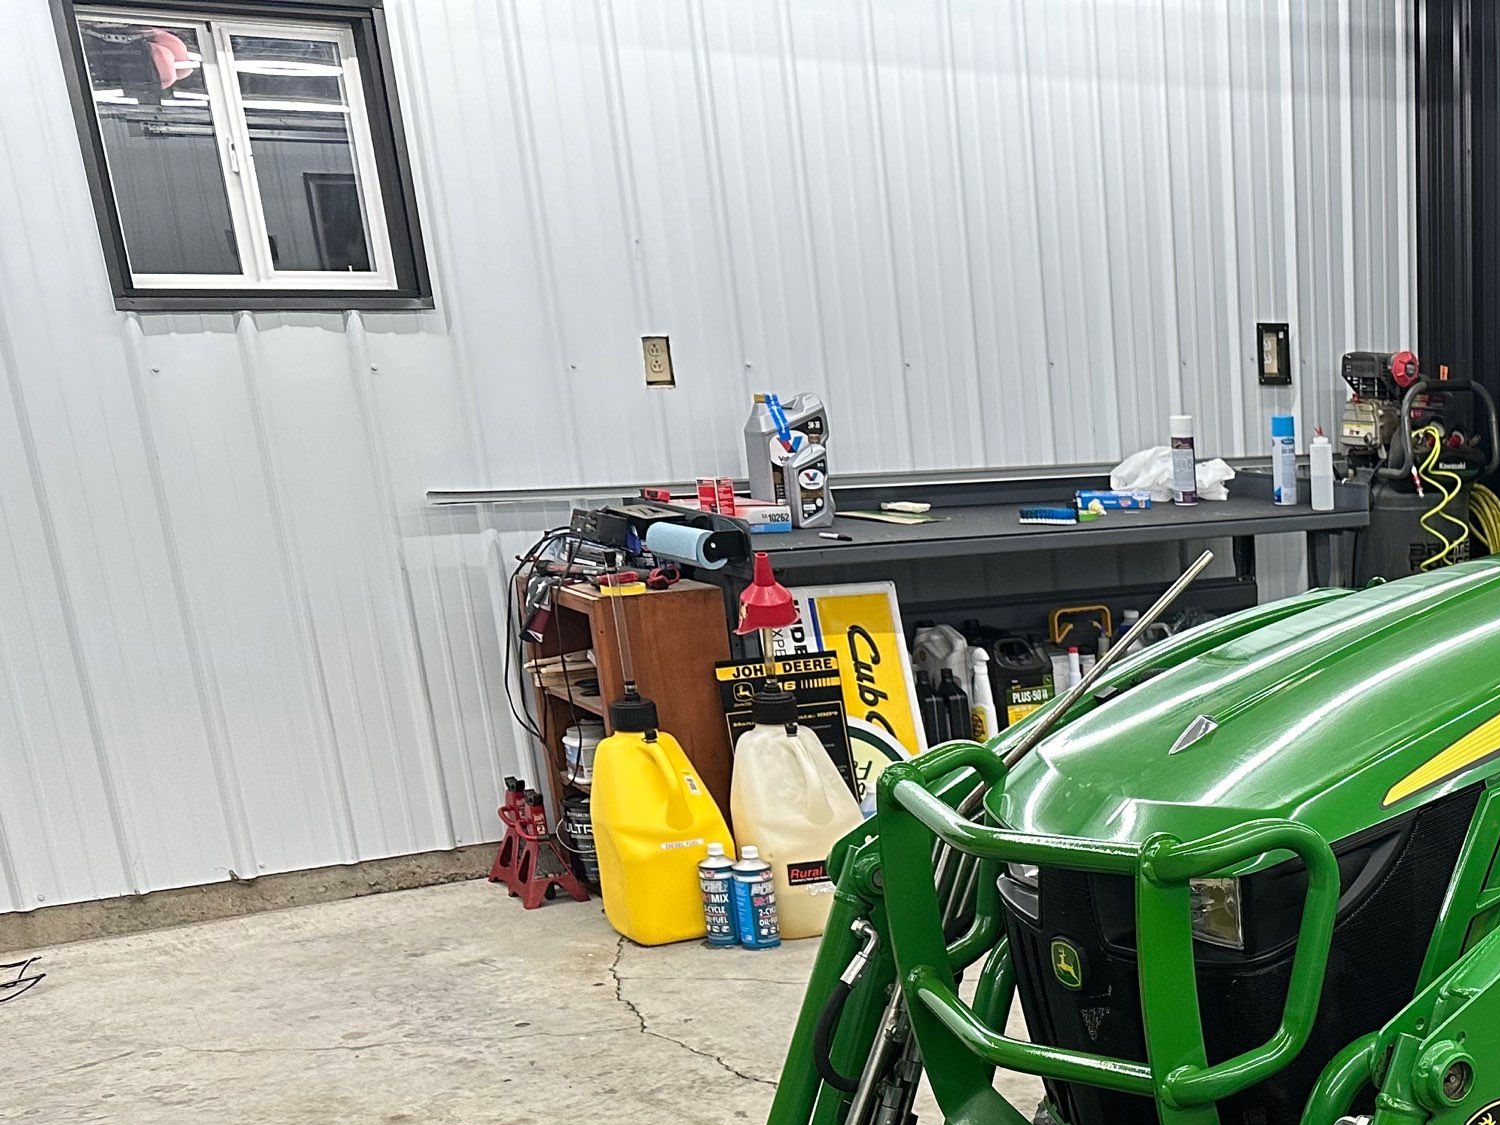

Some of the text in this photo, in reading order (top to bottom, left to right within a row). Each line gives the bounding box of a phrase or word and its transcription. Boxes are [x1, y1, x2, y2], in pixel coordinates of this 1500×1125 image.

[768, 512, 790, 522] 10262
[732, 658, 834, 679] JOH DEERE
[847, 624, 889, 707] Cub
[565, 822, 593, 835] ULTR
[790, 866, 823, 879] Rural
[711, 893, 729, 903] MIX
